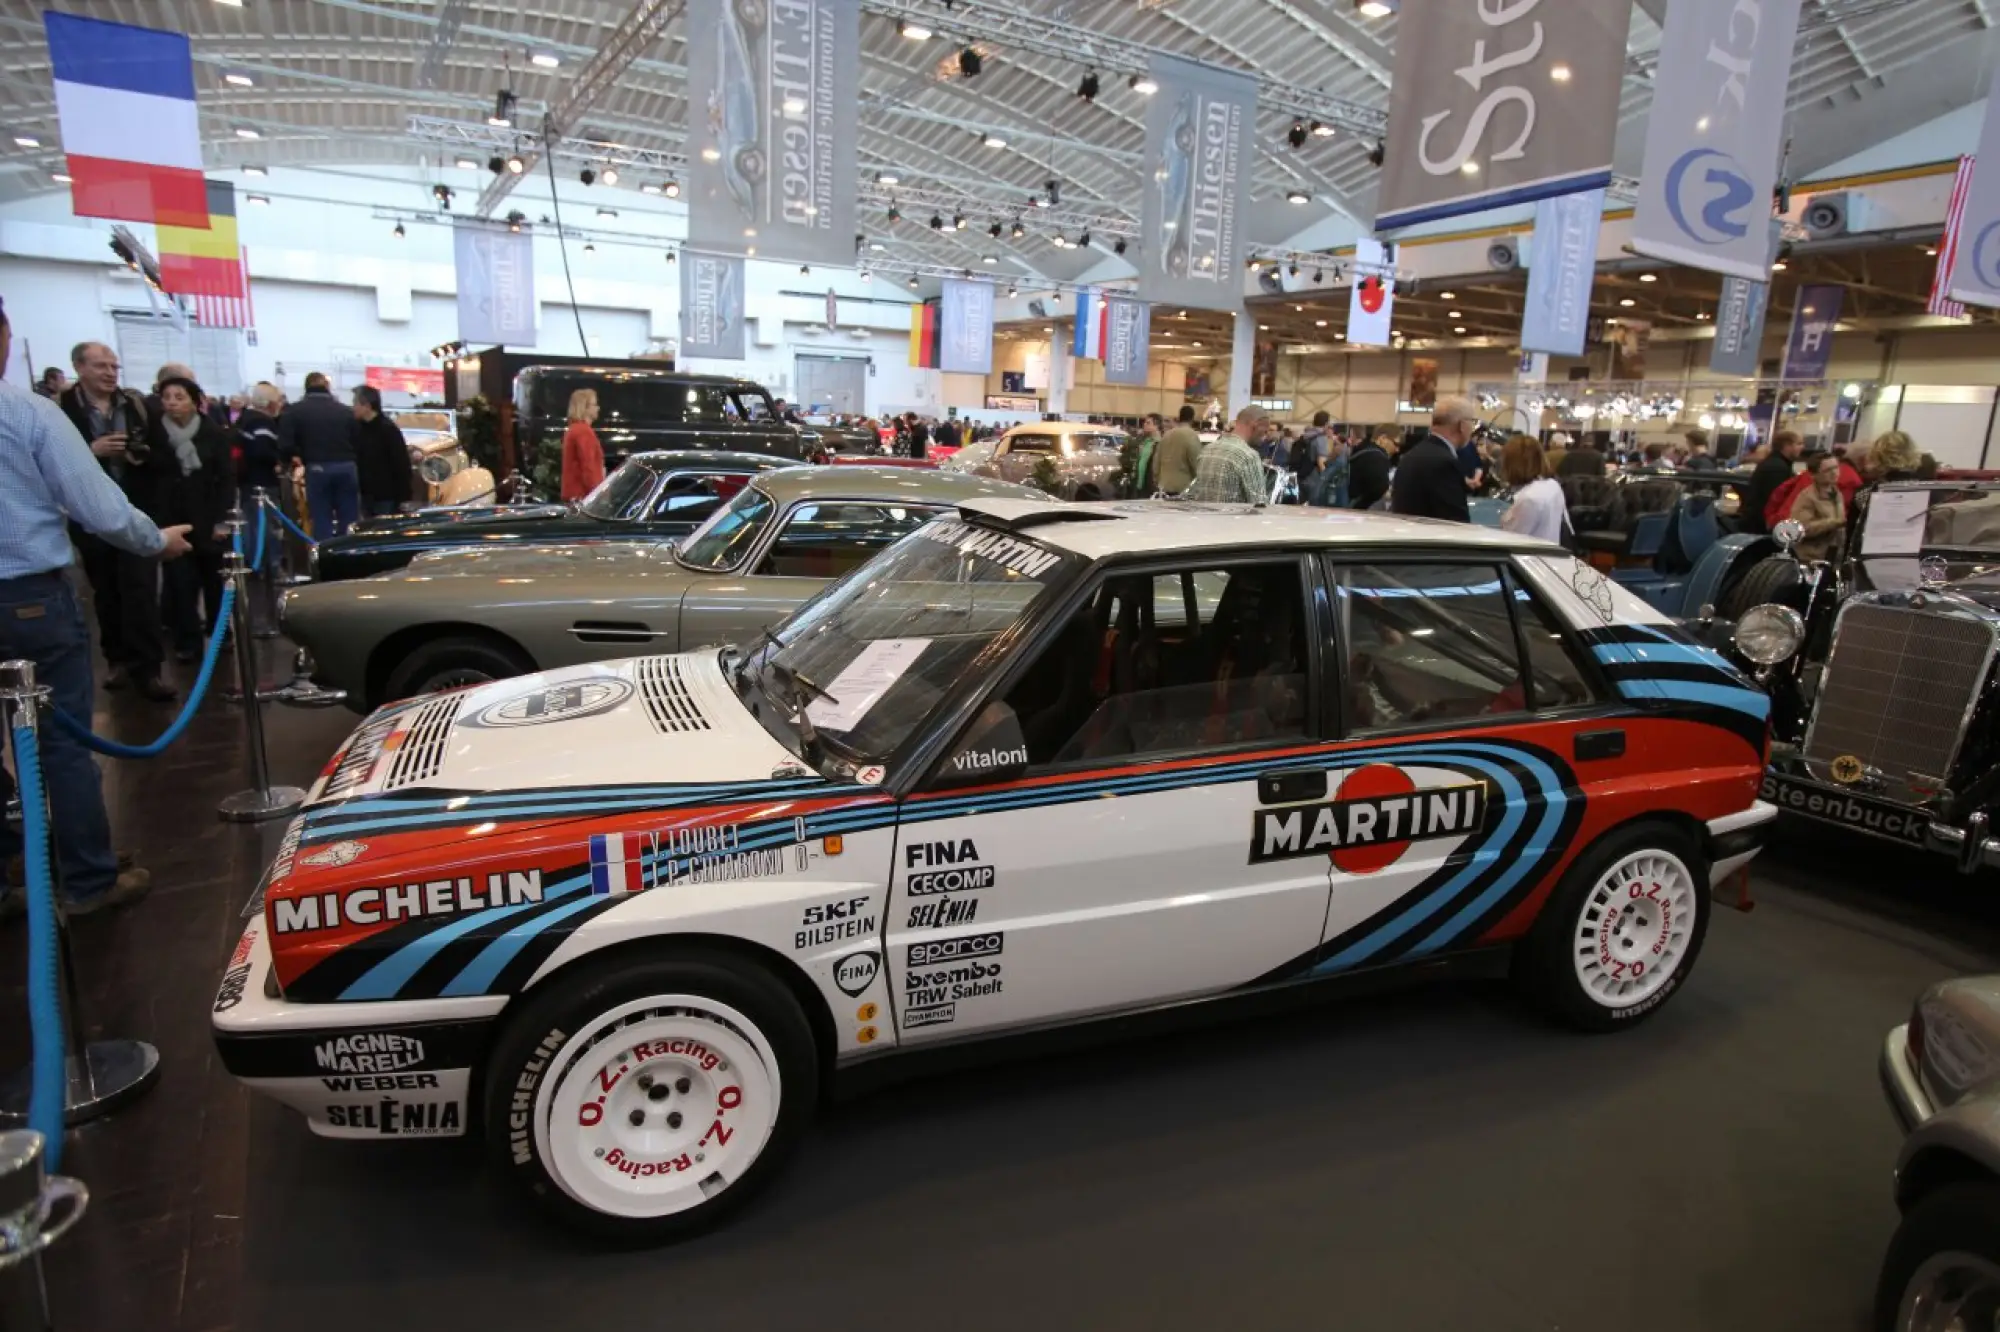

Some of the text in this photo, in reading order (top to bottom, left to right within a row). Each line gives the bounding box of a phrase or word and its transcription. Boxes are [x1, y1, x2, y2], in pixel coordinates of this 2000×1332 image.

[1192, 101, 1226, 245] Thiesen
[954, 525, 1062, 579] MARTINI
[952, 744, 1028, 771] vitaloni
[1262, 789, 1476, 856] MARTINI
[1759, 776, 1924, 839] Steenbuck
[669, 823, 740, 855] LOUBET
[906, 839, 979, 869] FINA
[909, 868, 994, 895] CECOMP
[273, 869, 545, 935] MICHELIN
[802, 896, 870, 925] SKF
[794, 916, 876, 949] BILSTEIN
[910, 935, 1002, 964] sparco
[839, 962, 874, 982] FINA
[906, 961, 1001, 989] brembo
[906, 979, 1003, 1007] TRW Sabelt
[632, 1039, 720, 1071] Racing
[322, 1074, 440, 1092] WEBER
[509, 1028, 567, 1165] MICHELIN
[326, 1095, 460, 1134] SELÈNIA
[604, 1148, 692, 1180] Racing
